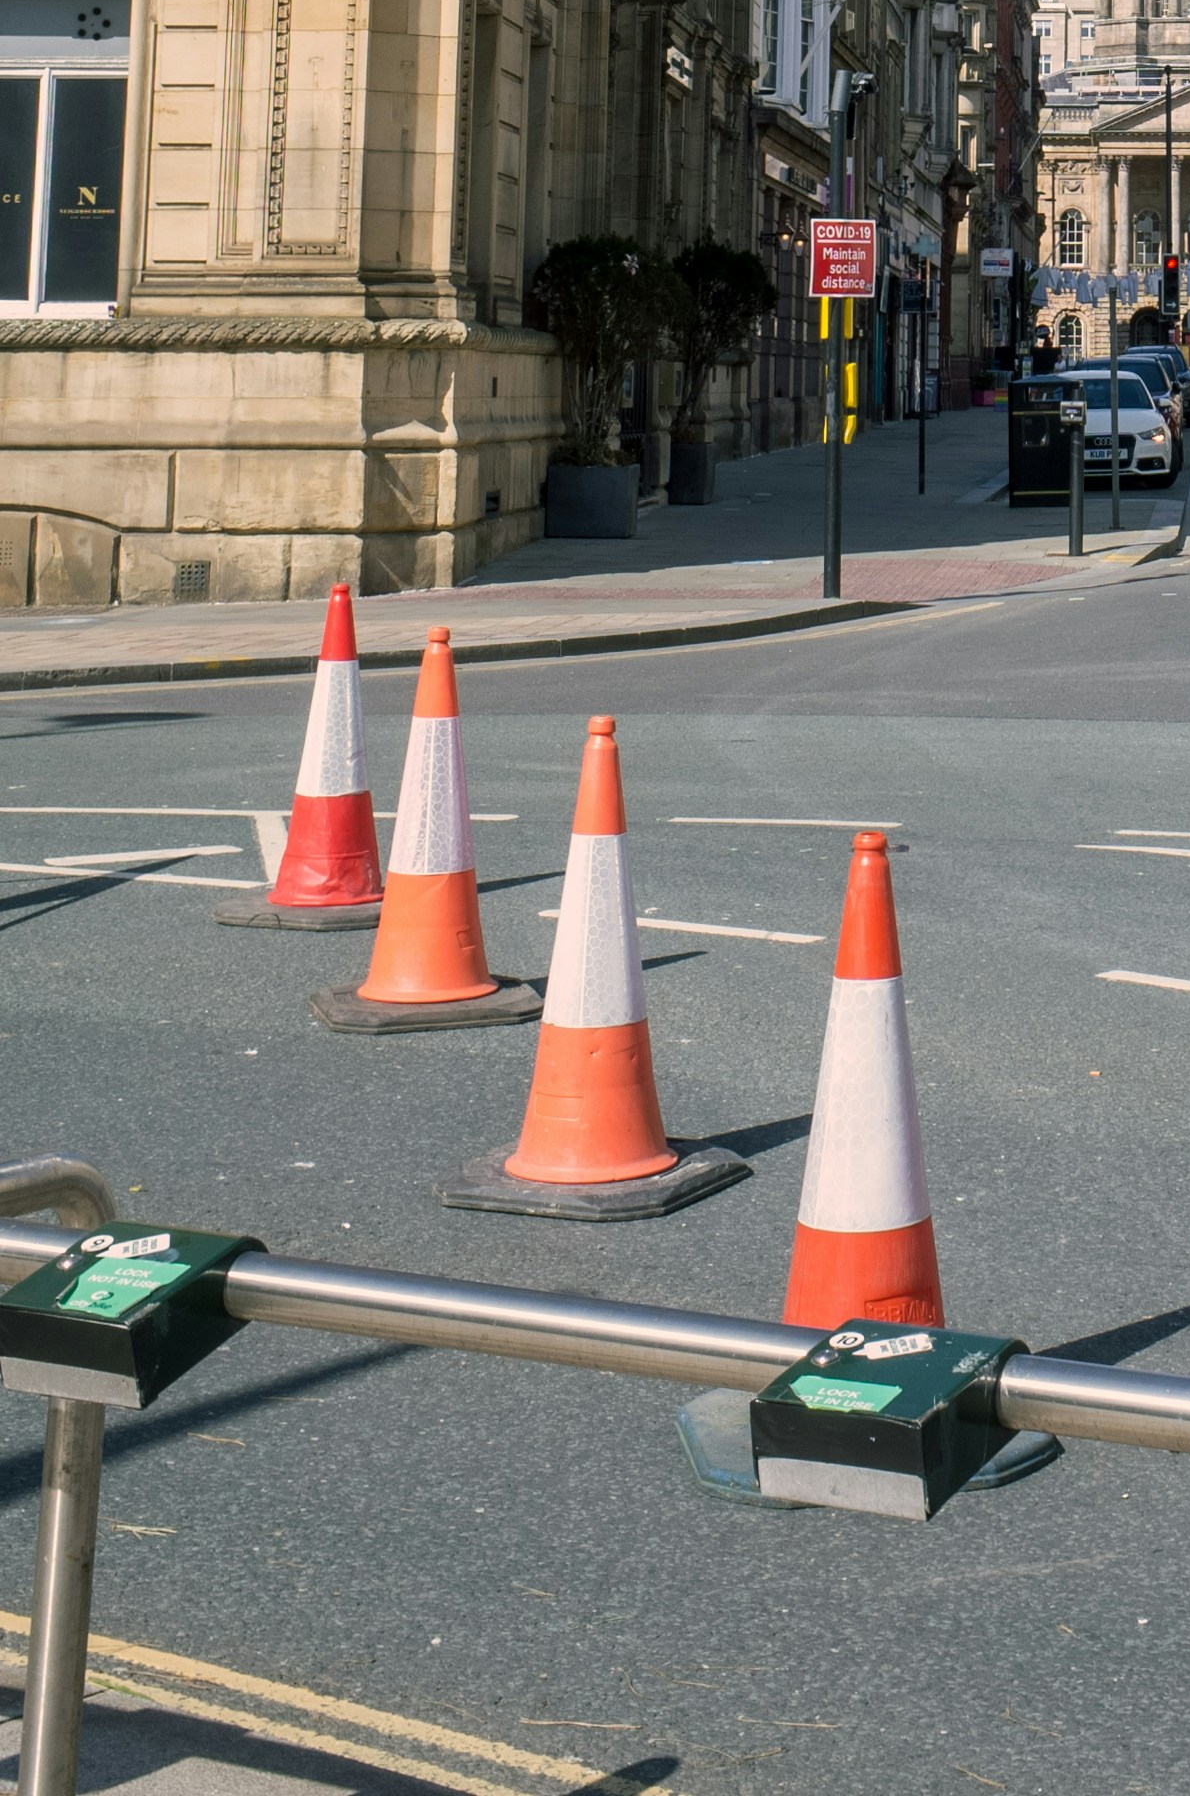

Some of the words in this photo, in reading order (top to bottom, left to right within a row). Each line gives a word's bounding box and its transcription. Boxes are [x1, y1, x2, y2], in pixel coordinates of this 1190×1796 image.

[77, 186, 99, 205] N
[816, 225, 872, 239] COVID-19
[823, 247, 866, 260] Maintain
[829, 261, 860, 274] social
[821, 276, 865, 289] distance
[114, 1268, 153, 1278] LOCK
[87, 1274, 118, 1284] NOT
[132, 1279, 161, 1290] USE
[836, 1335, 857, 1346] 10
[817, 1387, 861, 1399] LOCK
[823, 1397, 842, 1406] IN
[843, 1399, 876, 1410] USE
